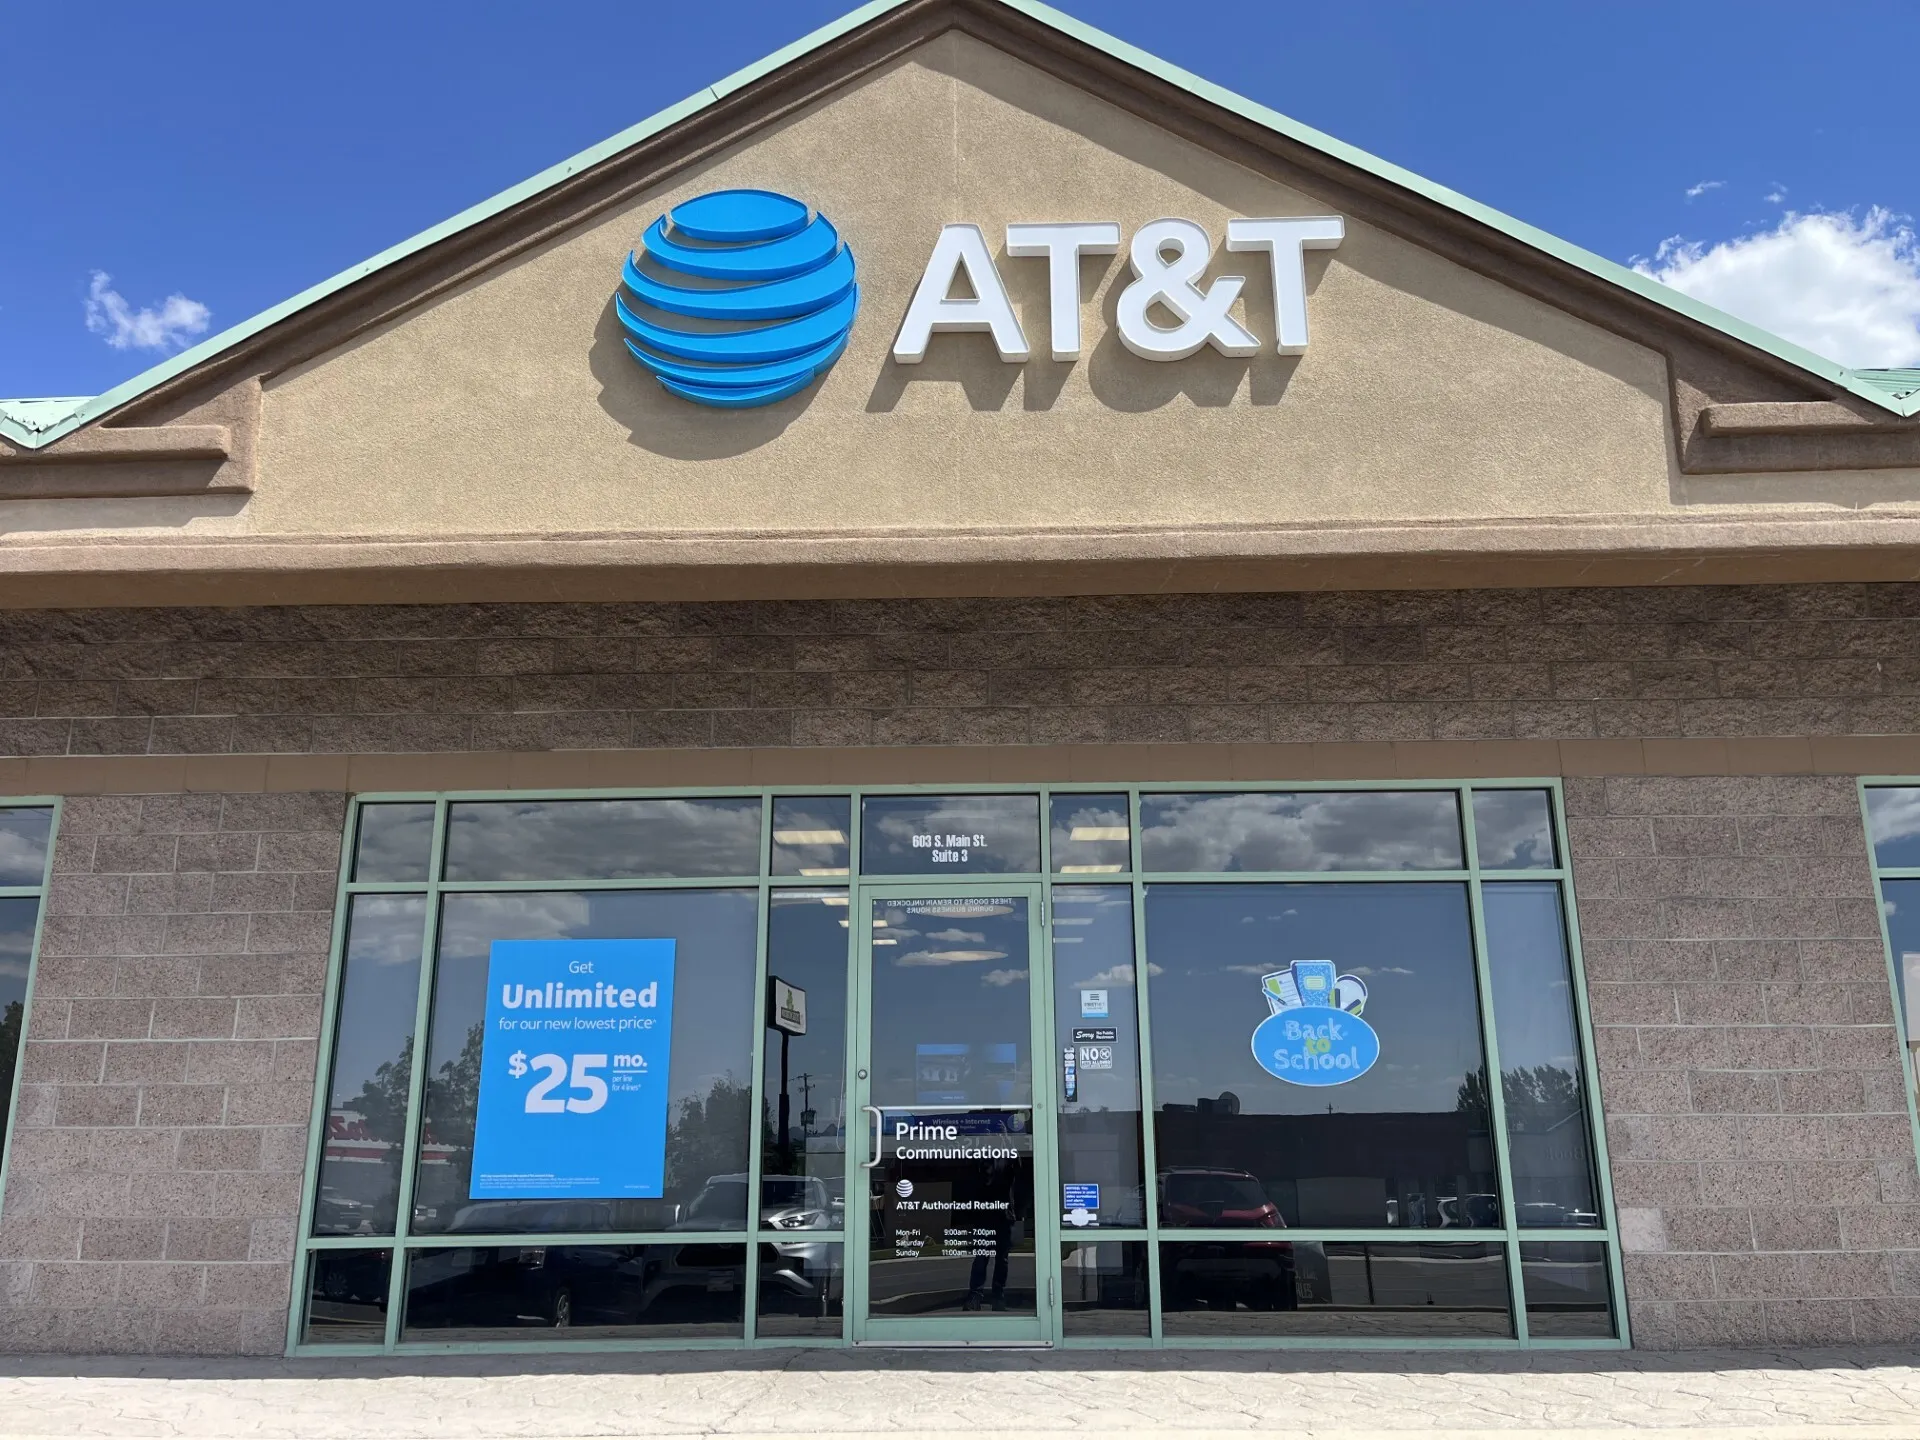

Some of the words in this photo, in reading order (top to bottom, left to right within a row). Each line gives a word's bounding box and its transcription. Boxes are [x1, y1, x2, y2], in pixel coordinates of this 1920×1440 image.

[893, 215, 1346, 364] AT&T
[912, 835, 932, 848] 603
[934, 834, 944, 847] S.
[946, 834, 971, 847] Main
[973, 834, 988, 847] St.
[932, 850, 959, 863] Suite
[961, 850, 968, 862] 3
[568, 960, 594, 974] Get
[502, 981, 658, 1009] Unlimited
[498, 1017, 517, 1030] for
[519, 1020, 542, 1030] our
[544, 1020, 571, 1029] new
[574, 1017, 616, 1029] lowest
[1285, 1017, 1344, 1041] Back
[1305, 1038, 1331, 1055] to
[1081, 1047, 1099, 1061] NO
[1273, 1046, 1360, 1070] School
[508, 1050, 608, 1114] $25
[613, 1054, 648, 1068] mo.
[896, 1121, 957, 1140] Prime
[896, 1145, 1018, 1160] Communications
[896, 1201, 920, 1210] AT&T
[922, 1201, 972, 1210] Authorized
[974, 1200, 1009, 1210] Retailer
[972, 1229, 997, 1237] 7:00pm
[895, 1239, 925, 1248] Saturday
[943, 1239, 967, 1247] 9:00am
[972, 1239, 997, 1247] 7:00pm
[895, 1249, 920, 1258] Sunday
